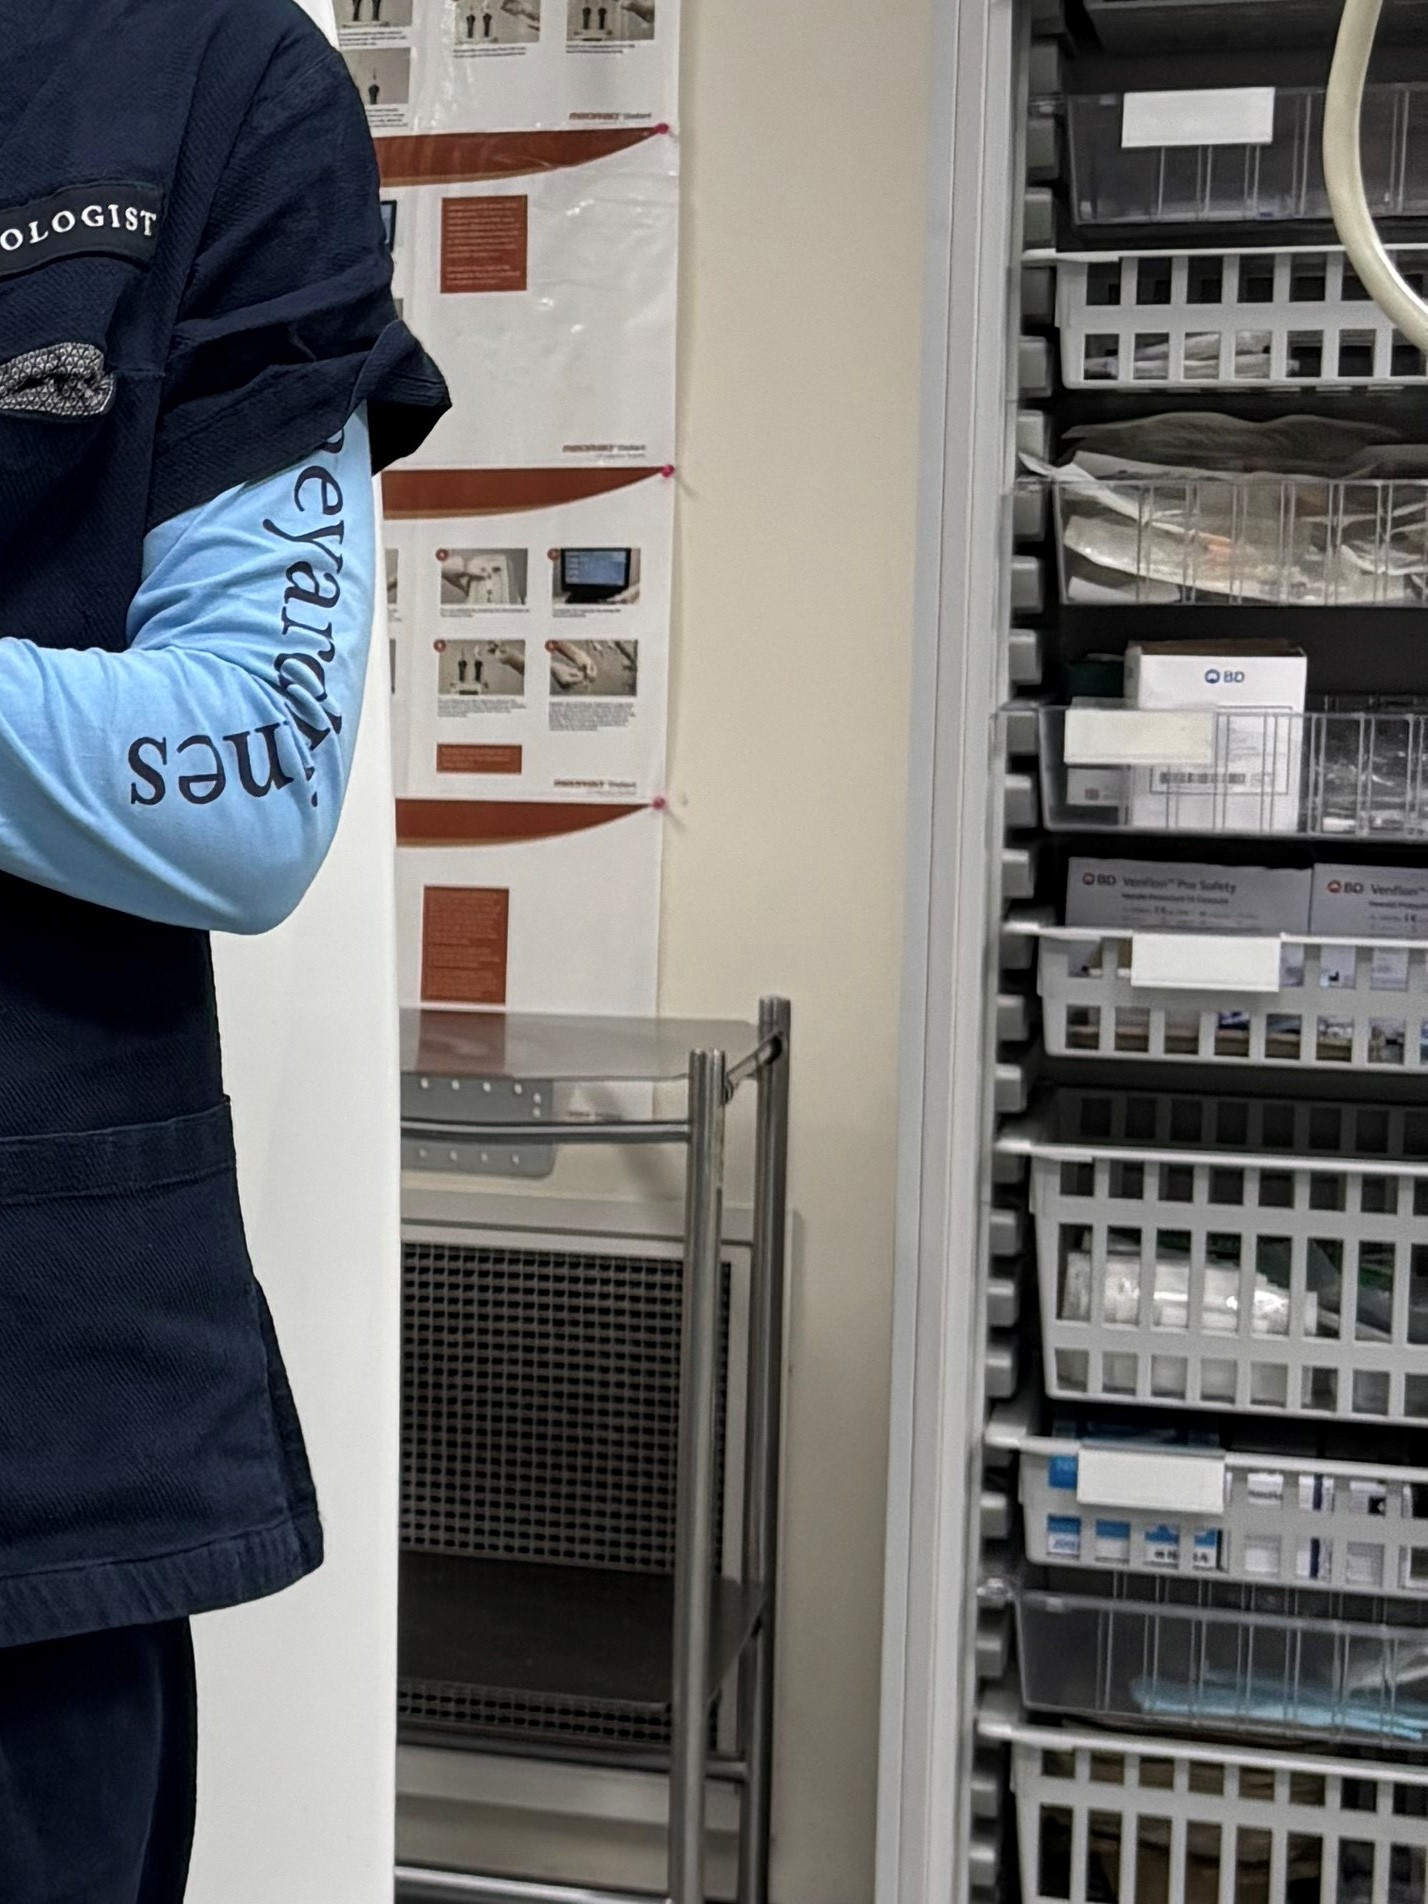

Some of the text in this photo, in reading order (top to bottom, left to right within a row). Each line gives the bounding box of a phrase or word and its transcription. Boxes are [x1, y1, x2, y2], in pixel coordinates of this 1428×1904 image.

[1223, 670, 1245, 683] BD
[1096, 875, 1117, 887] BD
[1199, 880, 1237, 895] Safety
